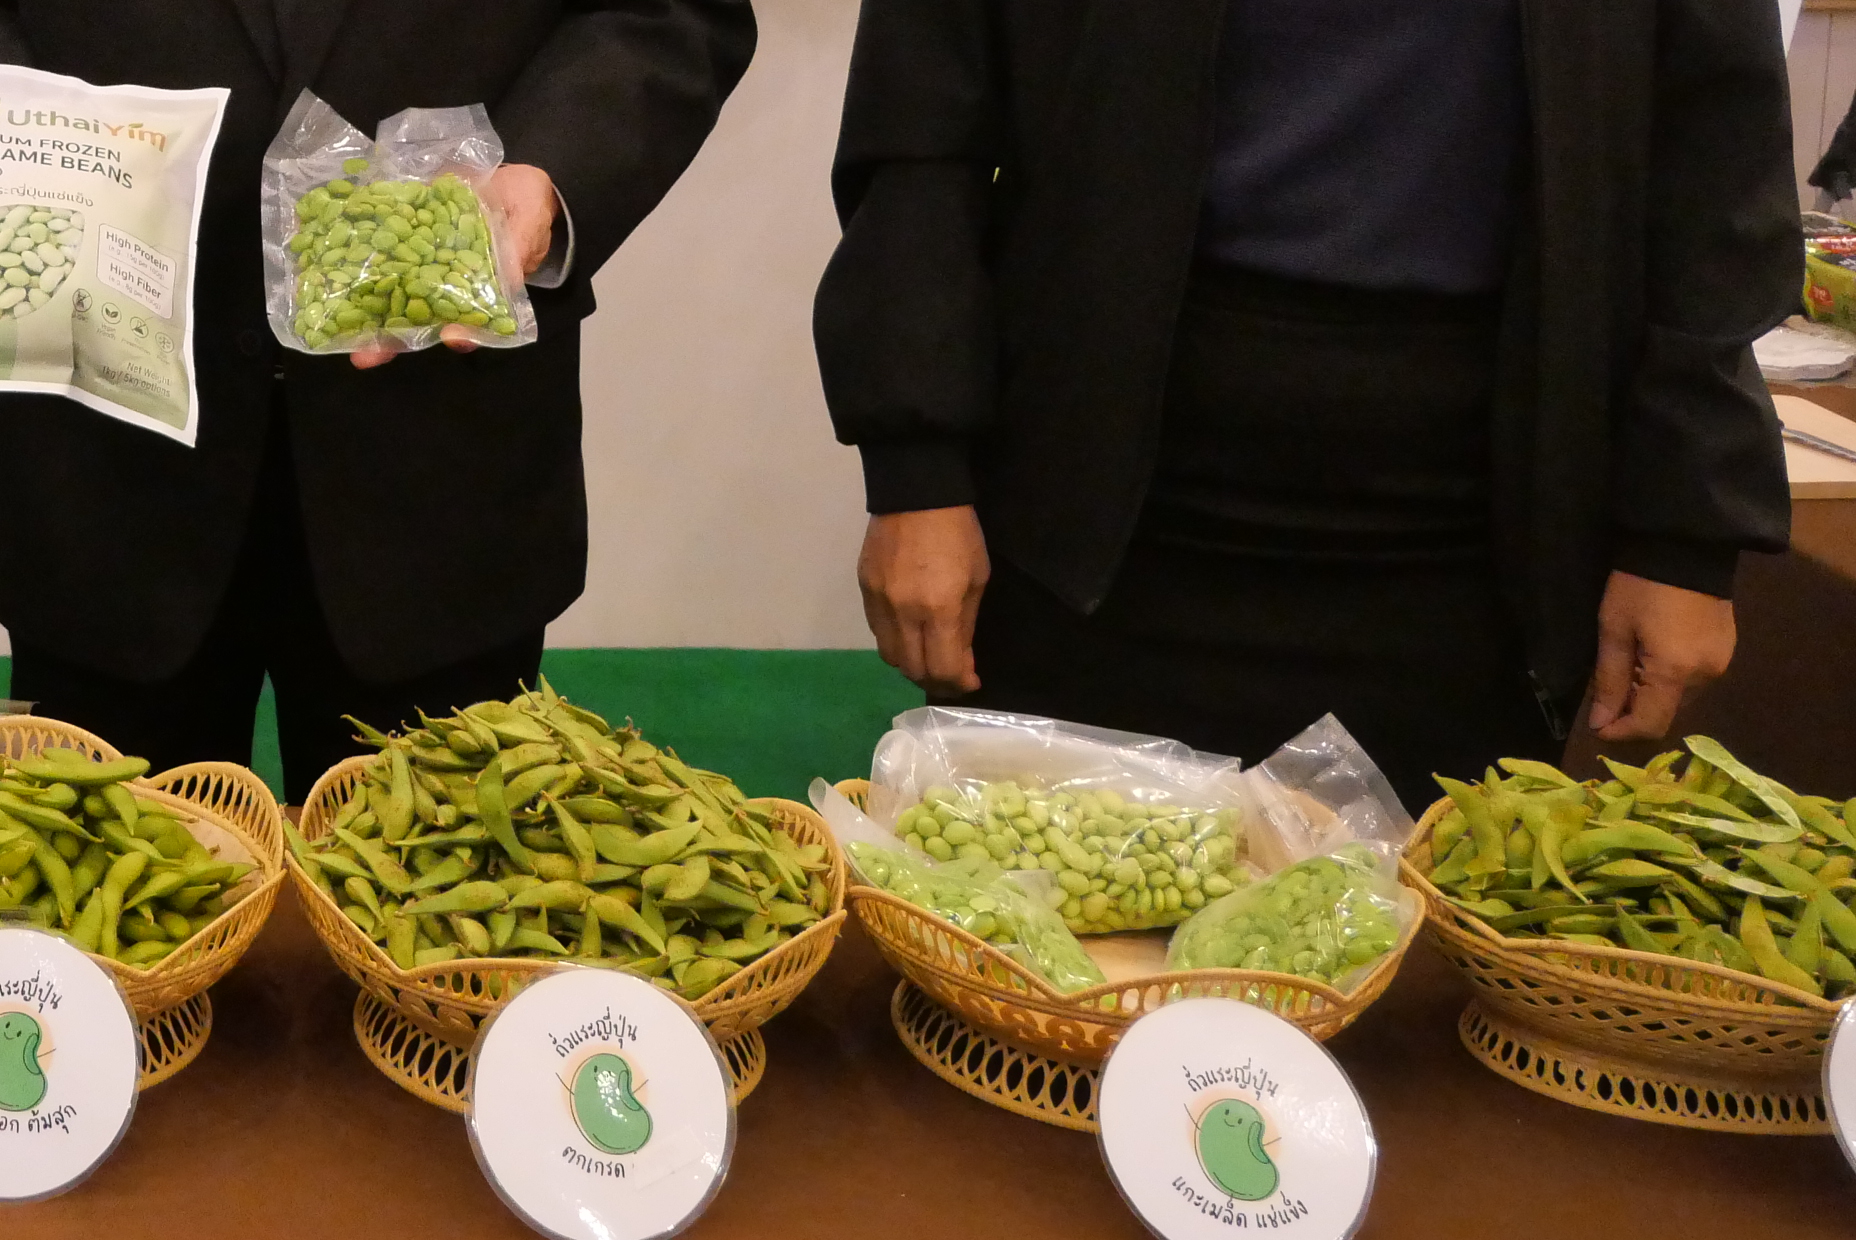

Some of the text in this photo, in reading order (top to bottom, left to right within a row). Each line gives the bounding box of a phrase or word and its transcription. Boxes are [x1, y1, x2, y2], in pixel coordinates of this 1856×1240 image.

[7, 109, 167, 153] UthaiYim
[39, 138, 122, 163] FROZEN
[60, 156, 134, 190] BEANS
[106, 231, 170, 273] High Protein
[109, 262, 162, 300] High Fiber
[126, 362, 142, 375] Net
[140, 379, 172, 398] options
[547, 1005, 638, 1058] ถั่วแระญี่ปุ่น
[1181, 1057, 1280, 1101] ถั่วแระญี่ปุ่น
[27, 1104, 78, 1134] ต้มสุก
[561, 1145, 626, 1179] ตกเกรด
[1171, 1175, 1309, 1228] แกะเมล็ด แช่แข็ง
